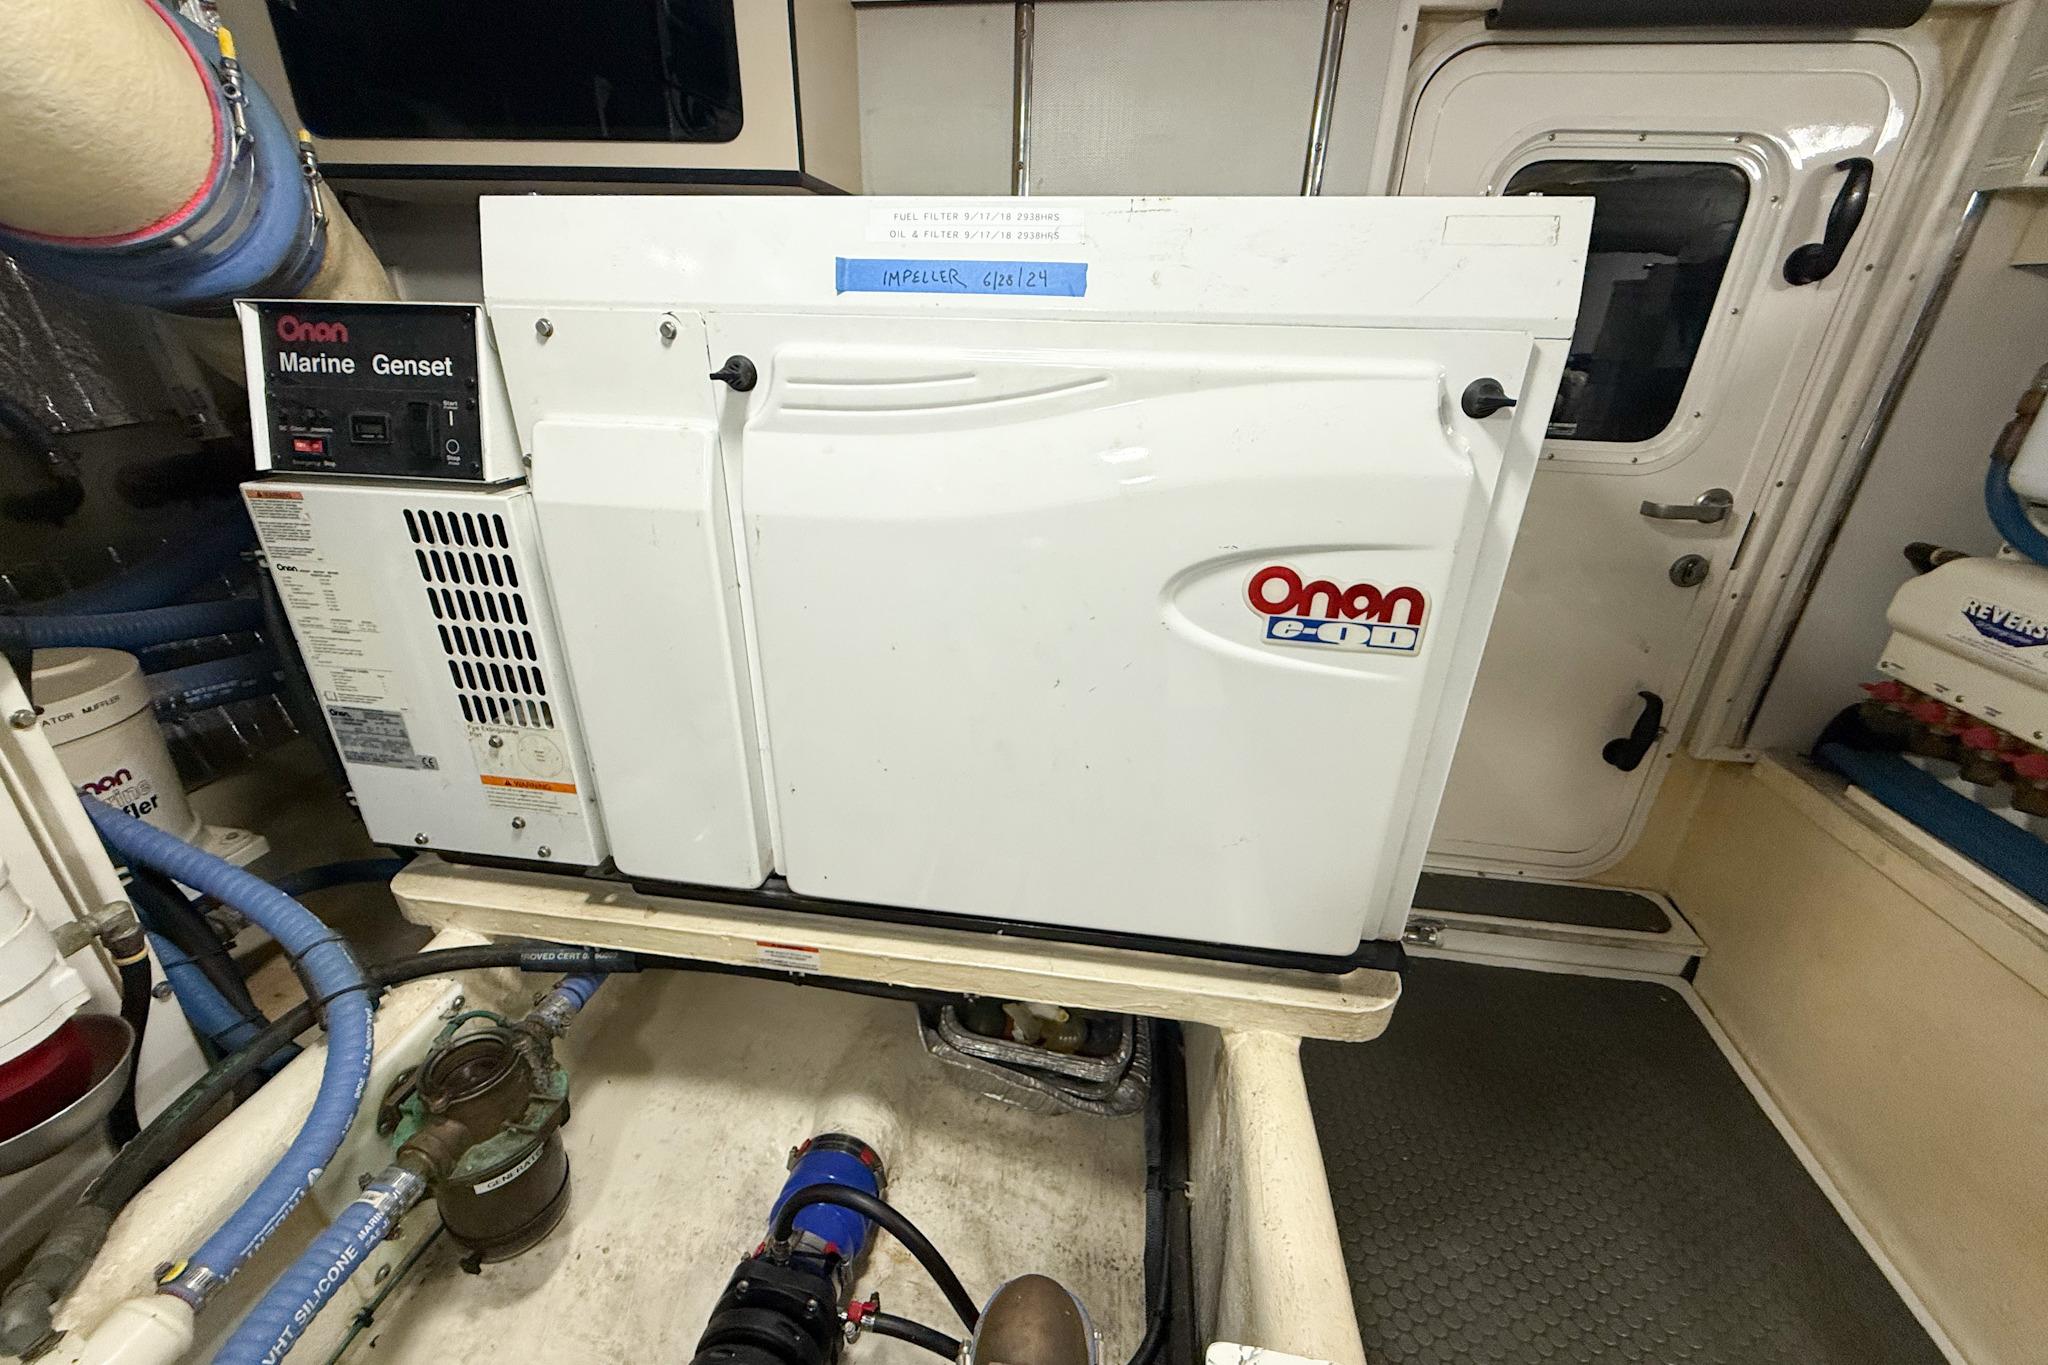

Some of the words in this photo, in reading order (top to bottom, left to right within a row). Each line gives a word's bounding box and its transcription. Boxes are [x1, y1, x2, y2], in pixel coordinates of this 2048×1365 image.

[893, 213, 918, 221] FUEL
[923, 213, 959, 221] FILTER
[963, 213, 1012, 221] 9/17/18
[1016, 213, 1060, 221] 2938HRS
[889, 230, 907, 240] OIL
[912, 230, 919, 240] &
[923, 230, 959, 240] FILTER
[963, 230, 1012, 240] 9/17/18
[1016, 230, 1060, 240] 2938HRS
[882, 268, 968, 289] IMPELLER
[982, 267, 1049, 291] 6/28/24
[277, 314, 350, 343] Onan
[279, 351, 356, 375] Marine
[371, 353, 453, 377] Genset
[1248, 565, 1425, 625] Onan
[1960, 600, 2048, 640] REVERS
[81, 695, 120, 714] MUFFLER
[81, 768, 132, 796] nan
[556, 951, 582, 960] CERT
[487, 1145, 545, 1188] GENERATO
[294, 1244, 359, 1327] SILICONE
